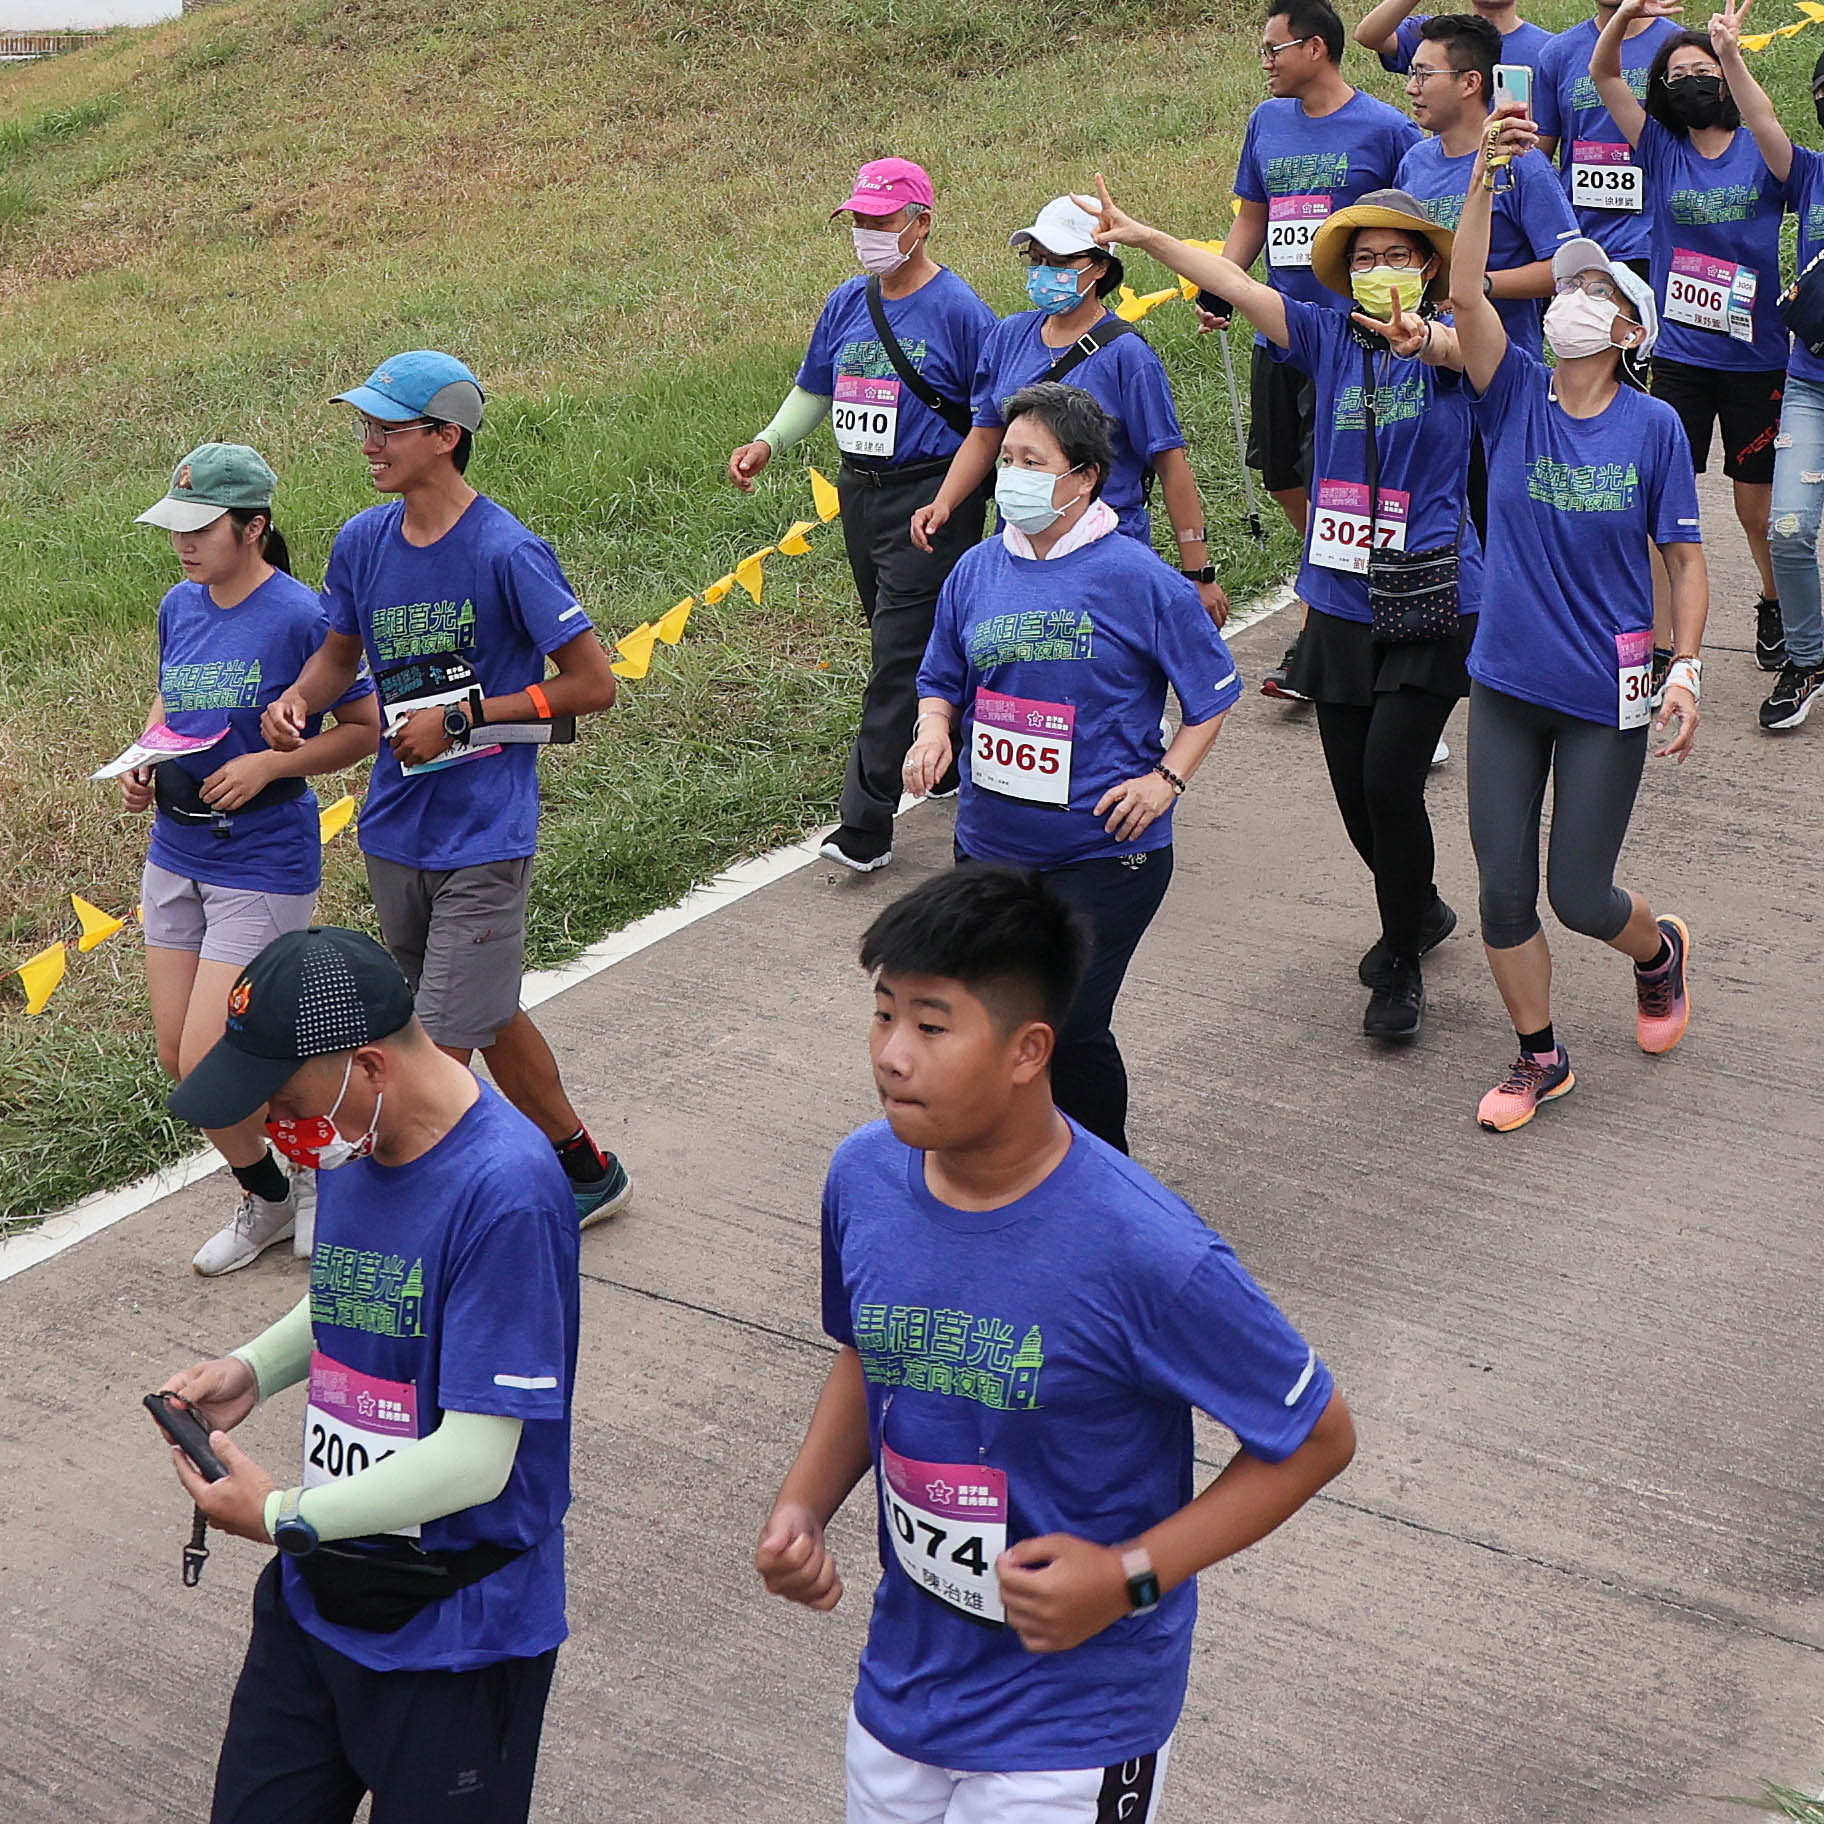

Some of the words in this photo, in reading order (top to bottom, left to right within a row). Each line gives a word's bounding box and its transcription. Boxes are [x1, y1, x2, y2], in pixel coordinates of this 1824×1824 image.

[1577, 169, 1636, 190] 2038
[1671, 279, 1723, 312] 3006
[836, 408, 888, 434] 2010
[1319, 517, 1397, 550] 3027
[1626, 675, 1650, 702] 30
[977, 733, 1060, 775] 3065
[854, 1303, 1015, 1374] 馬祖莒光
[901, 1358, 1005, 1409] 定向夜跑
[308, 1423, 397, 1478] 200
[885, 1494, 989, 1577] 074
[922, 1567, 985, 1613] 陳治雄
